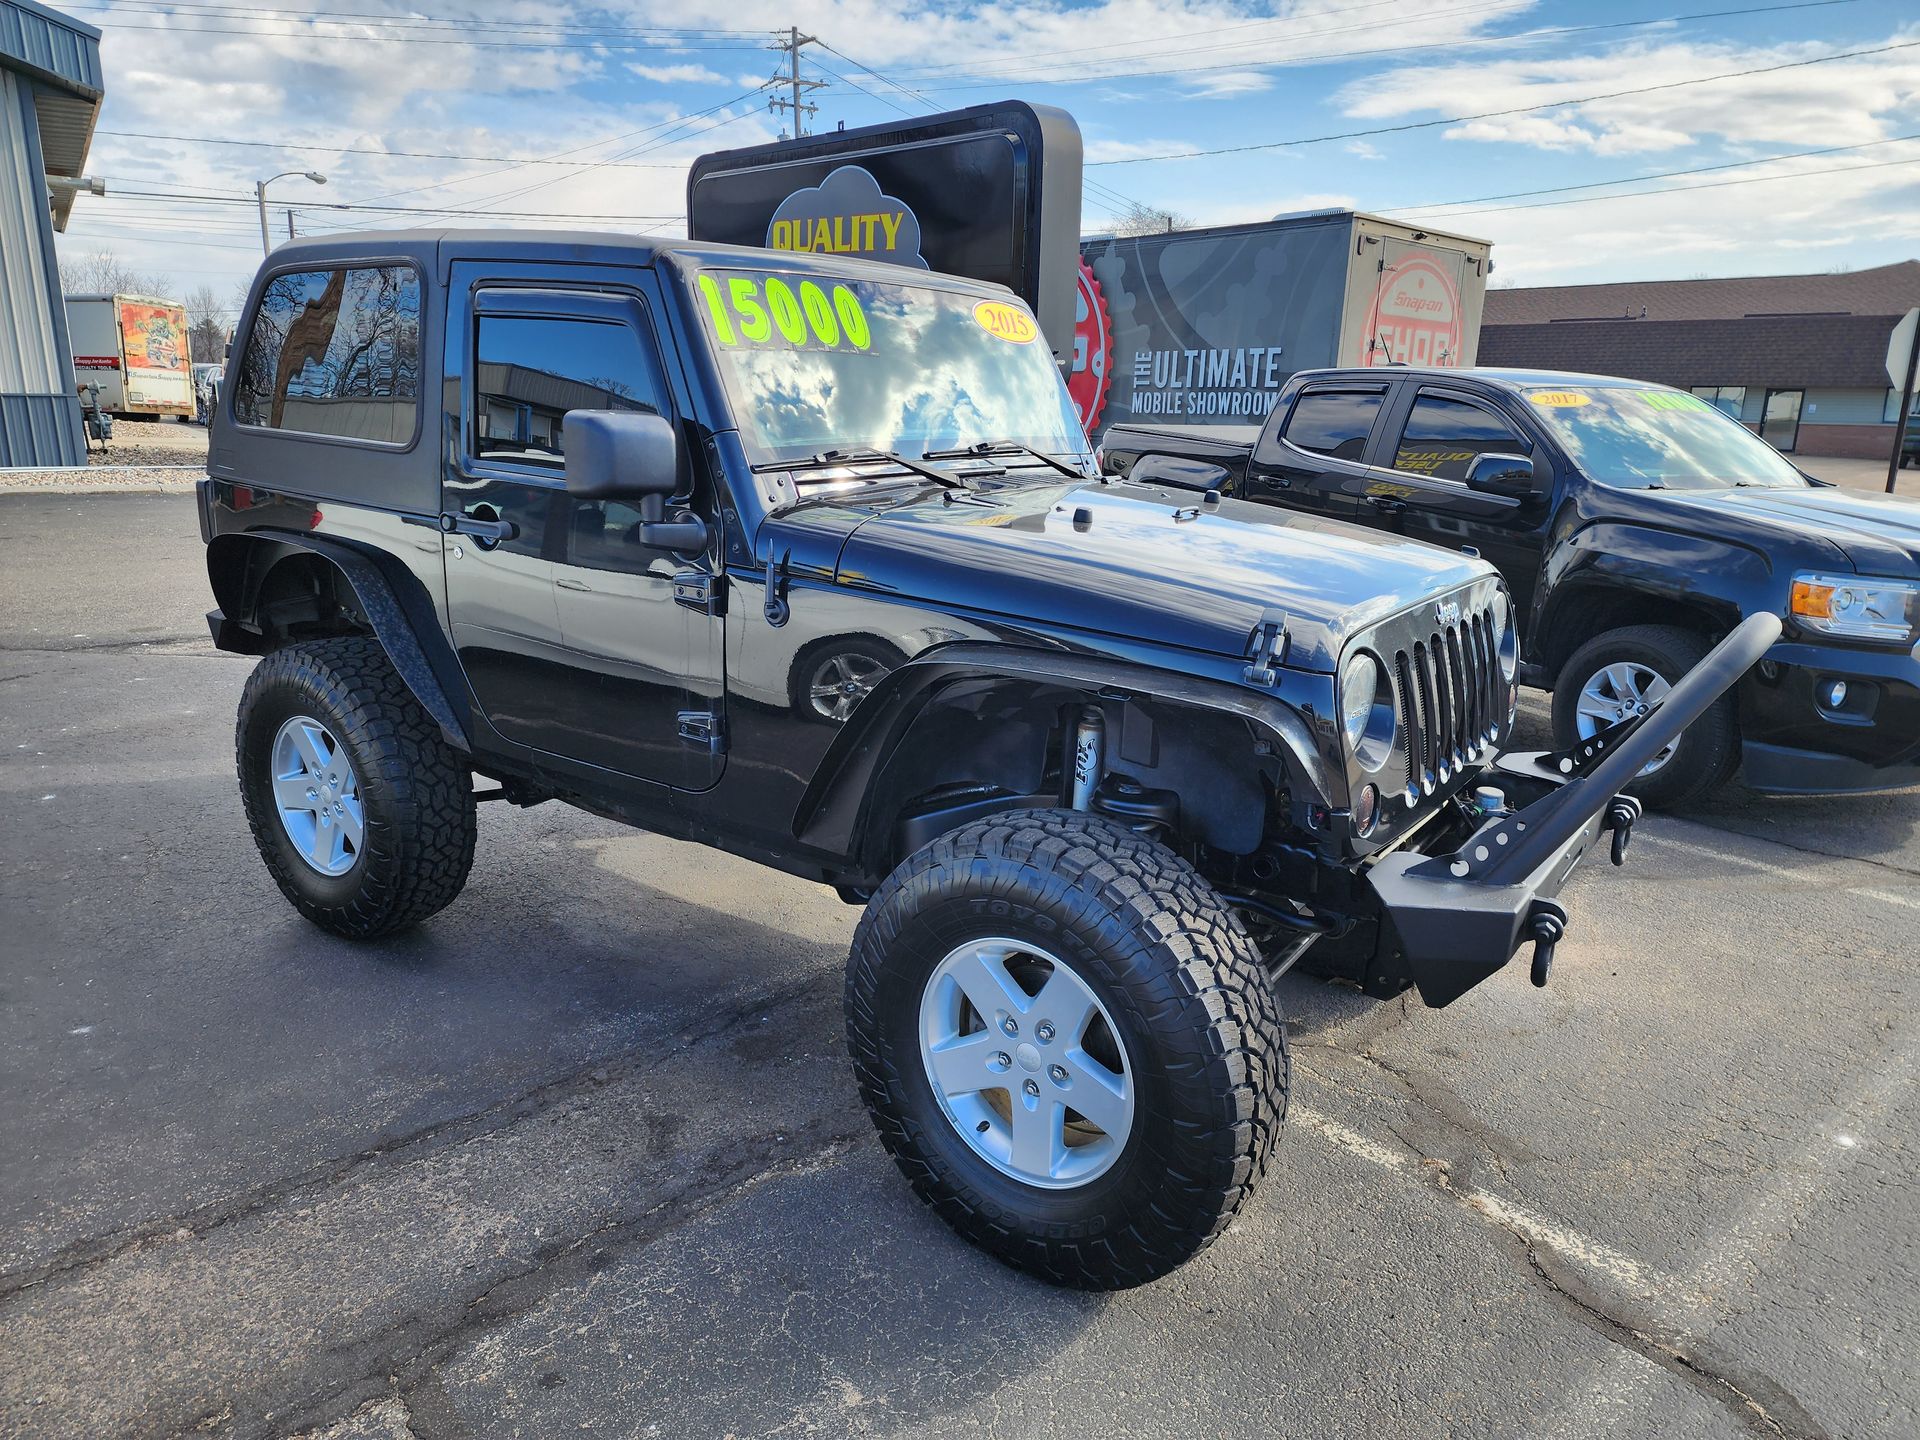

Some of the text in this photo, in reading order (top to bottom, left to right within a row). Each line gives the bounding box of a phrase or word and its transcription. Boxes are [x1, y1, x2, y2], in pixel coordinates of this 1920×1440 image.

[773, 212, 903, 253] QUALITY
[698, 274, 871, 350] 15000
[1393, 291, 1443, 312] Snap-on
[984, 308, 1029, 335] 2015
[1372, 324, 1452, 368] SHOP
[1133, 351, 1152, 389] THE
[1154, 347, 1282, 389] ULTIMATE
[1131, 391, 1279, 416] MOBILE SHOWROOM
[1541, 394, 1578, 404] 2017
[1075, 737, 1093, 785] FOX
[969, 898, 1057, 932] TOYO
